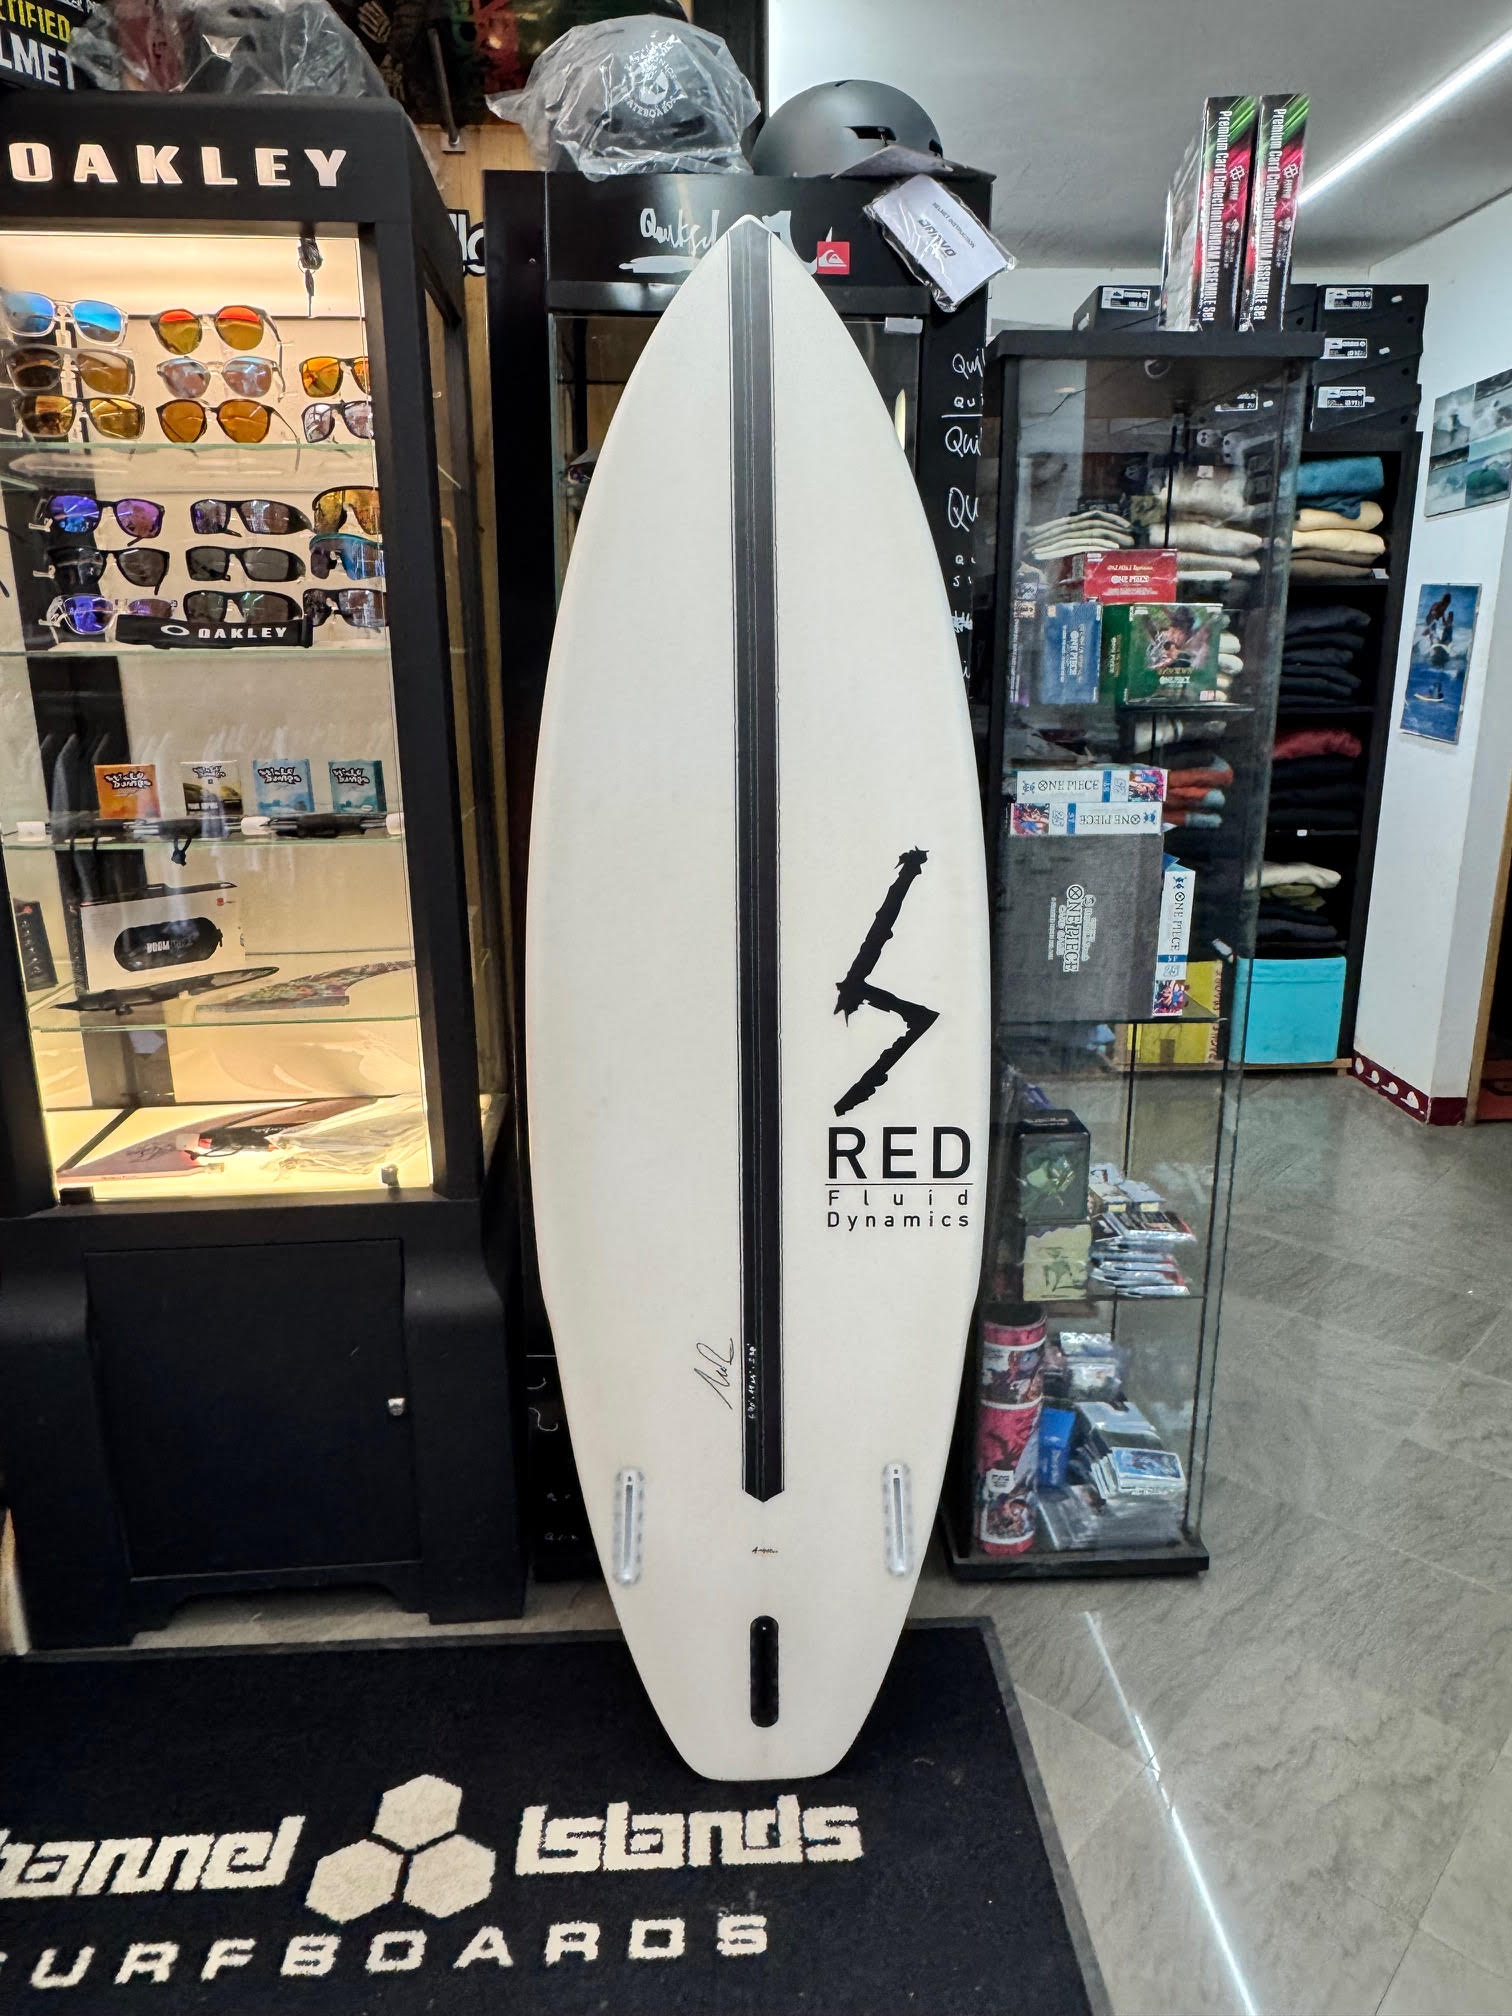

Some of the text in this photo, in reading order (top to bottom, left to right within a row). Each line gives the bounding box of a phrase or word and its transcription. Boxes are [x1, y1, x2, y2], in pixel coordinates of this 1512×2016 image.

[1216, 110, 1233, 150] Premium
[8, 142, 347, 188] OAKLEY
[1214, 152, 1229, 174] Card
[1209, 176, 1226, 221] Collection
[1252, 108, 1287, 320] Premium Card Collection GUNDAM ASSEMBLE Set
[1206, 221, 1222, 260] GUNDAM
[1201, 306, 1216, 322] Set
[198, 626, 288, 639] OAKLEY
[1038, 779, 1100, 792] ONE PIECE
[1079, 815, 1141, 826] ONE PIECE
[1063, 885, 1086, 972] ONE PIECE
[1170, 892, 1186, 952] ONE PIECE
[828, 1126, 971, 1179] RED
[828, 1189, 968, 1206] Fluid
[827, 1211, 969, 1232] Dynamics
[515, 1794, 865, 1876] Islands
[0, 1915, 768, 1990] URFBOARDS
